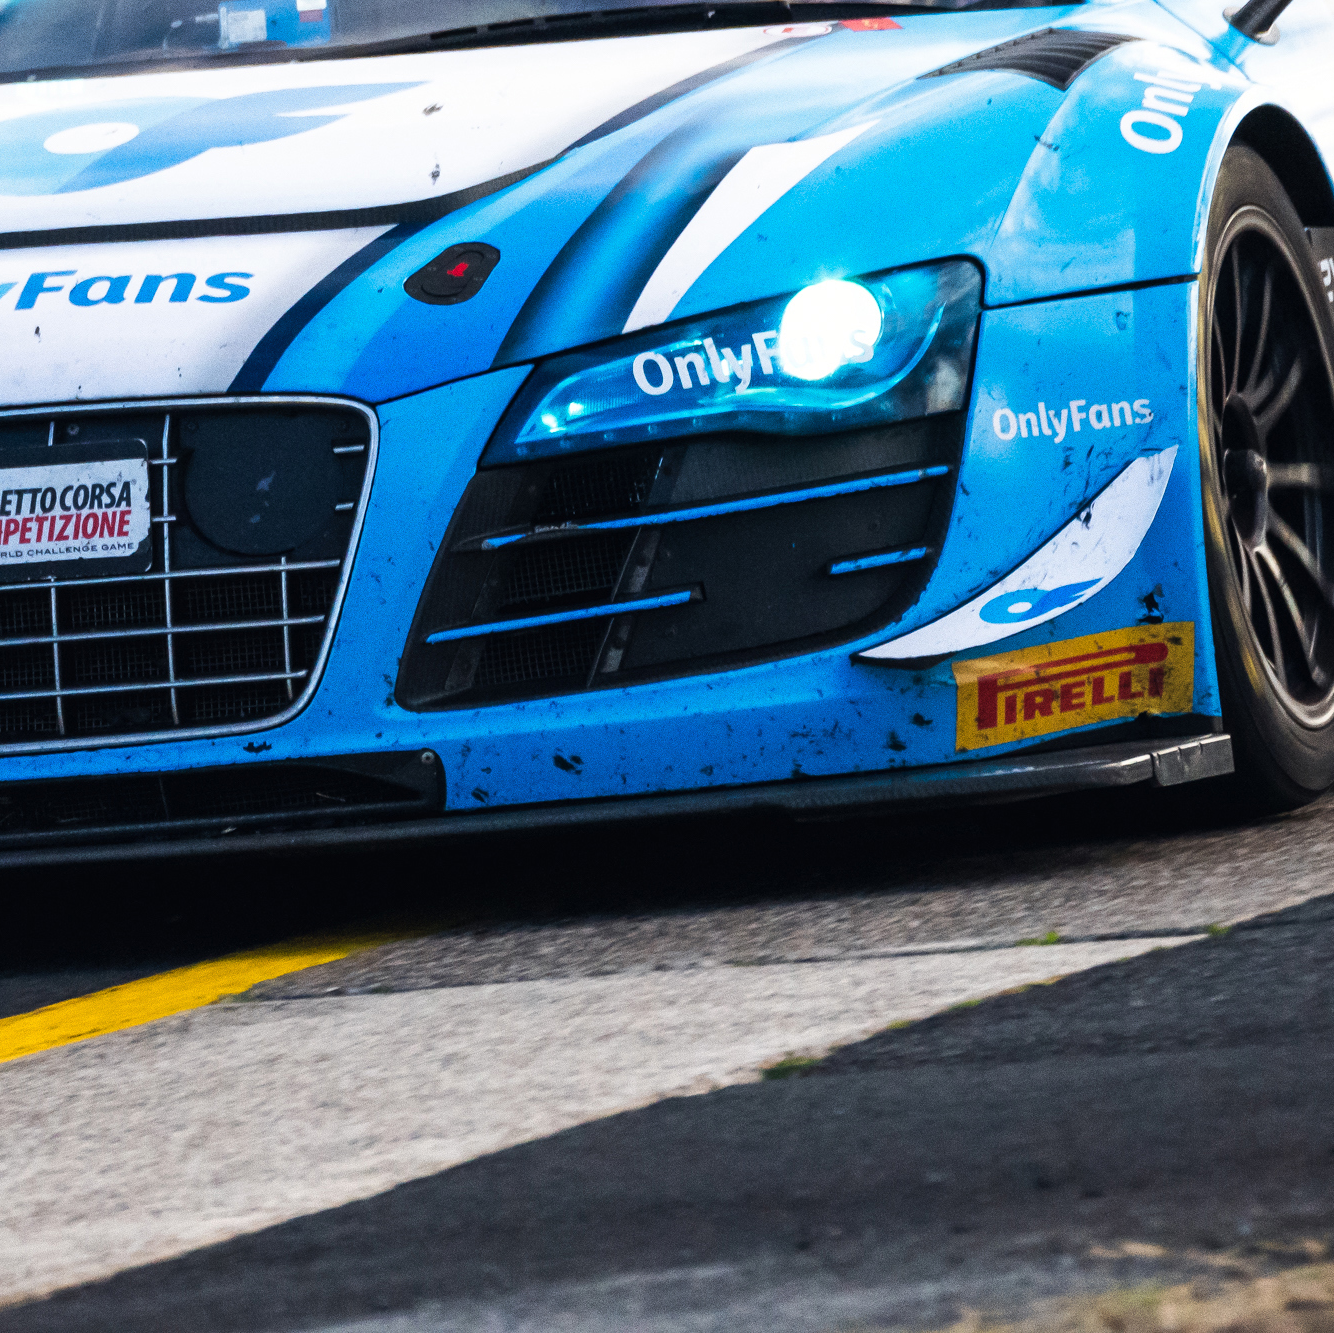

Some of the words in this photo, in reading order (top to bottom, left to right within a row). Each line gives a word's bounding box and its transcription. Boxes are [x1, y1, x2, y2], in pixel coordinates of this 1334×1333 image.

[992, 398, 1154, 444] OnlyFans
[59, 480, 132, 512] CORSA
[27, 545, 98, 557] CHALLENGE
[101, 542, 135, 552] GAME
[976, 642, 1169, 731] PIRELLI
